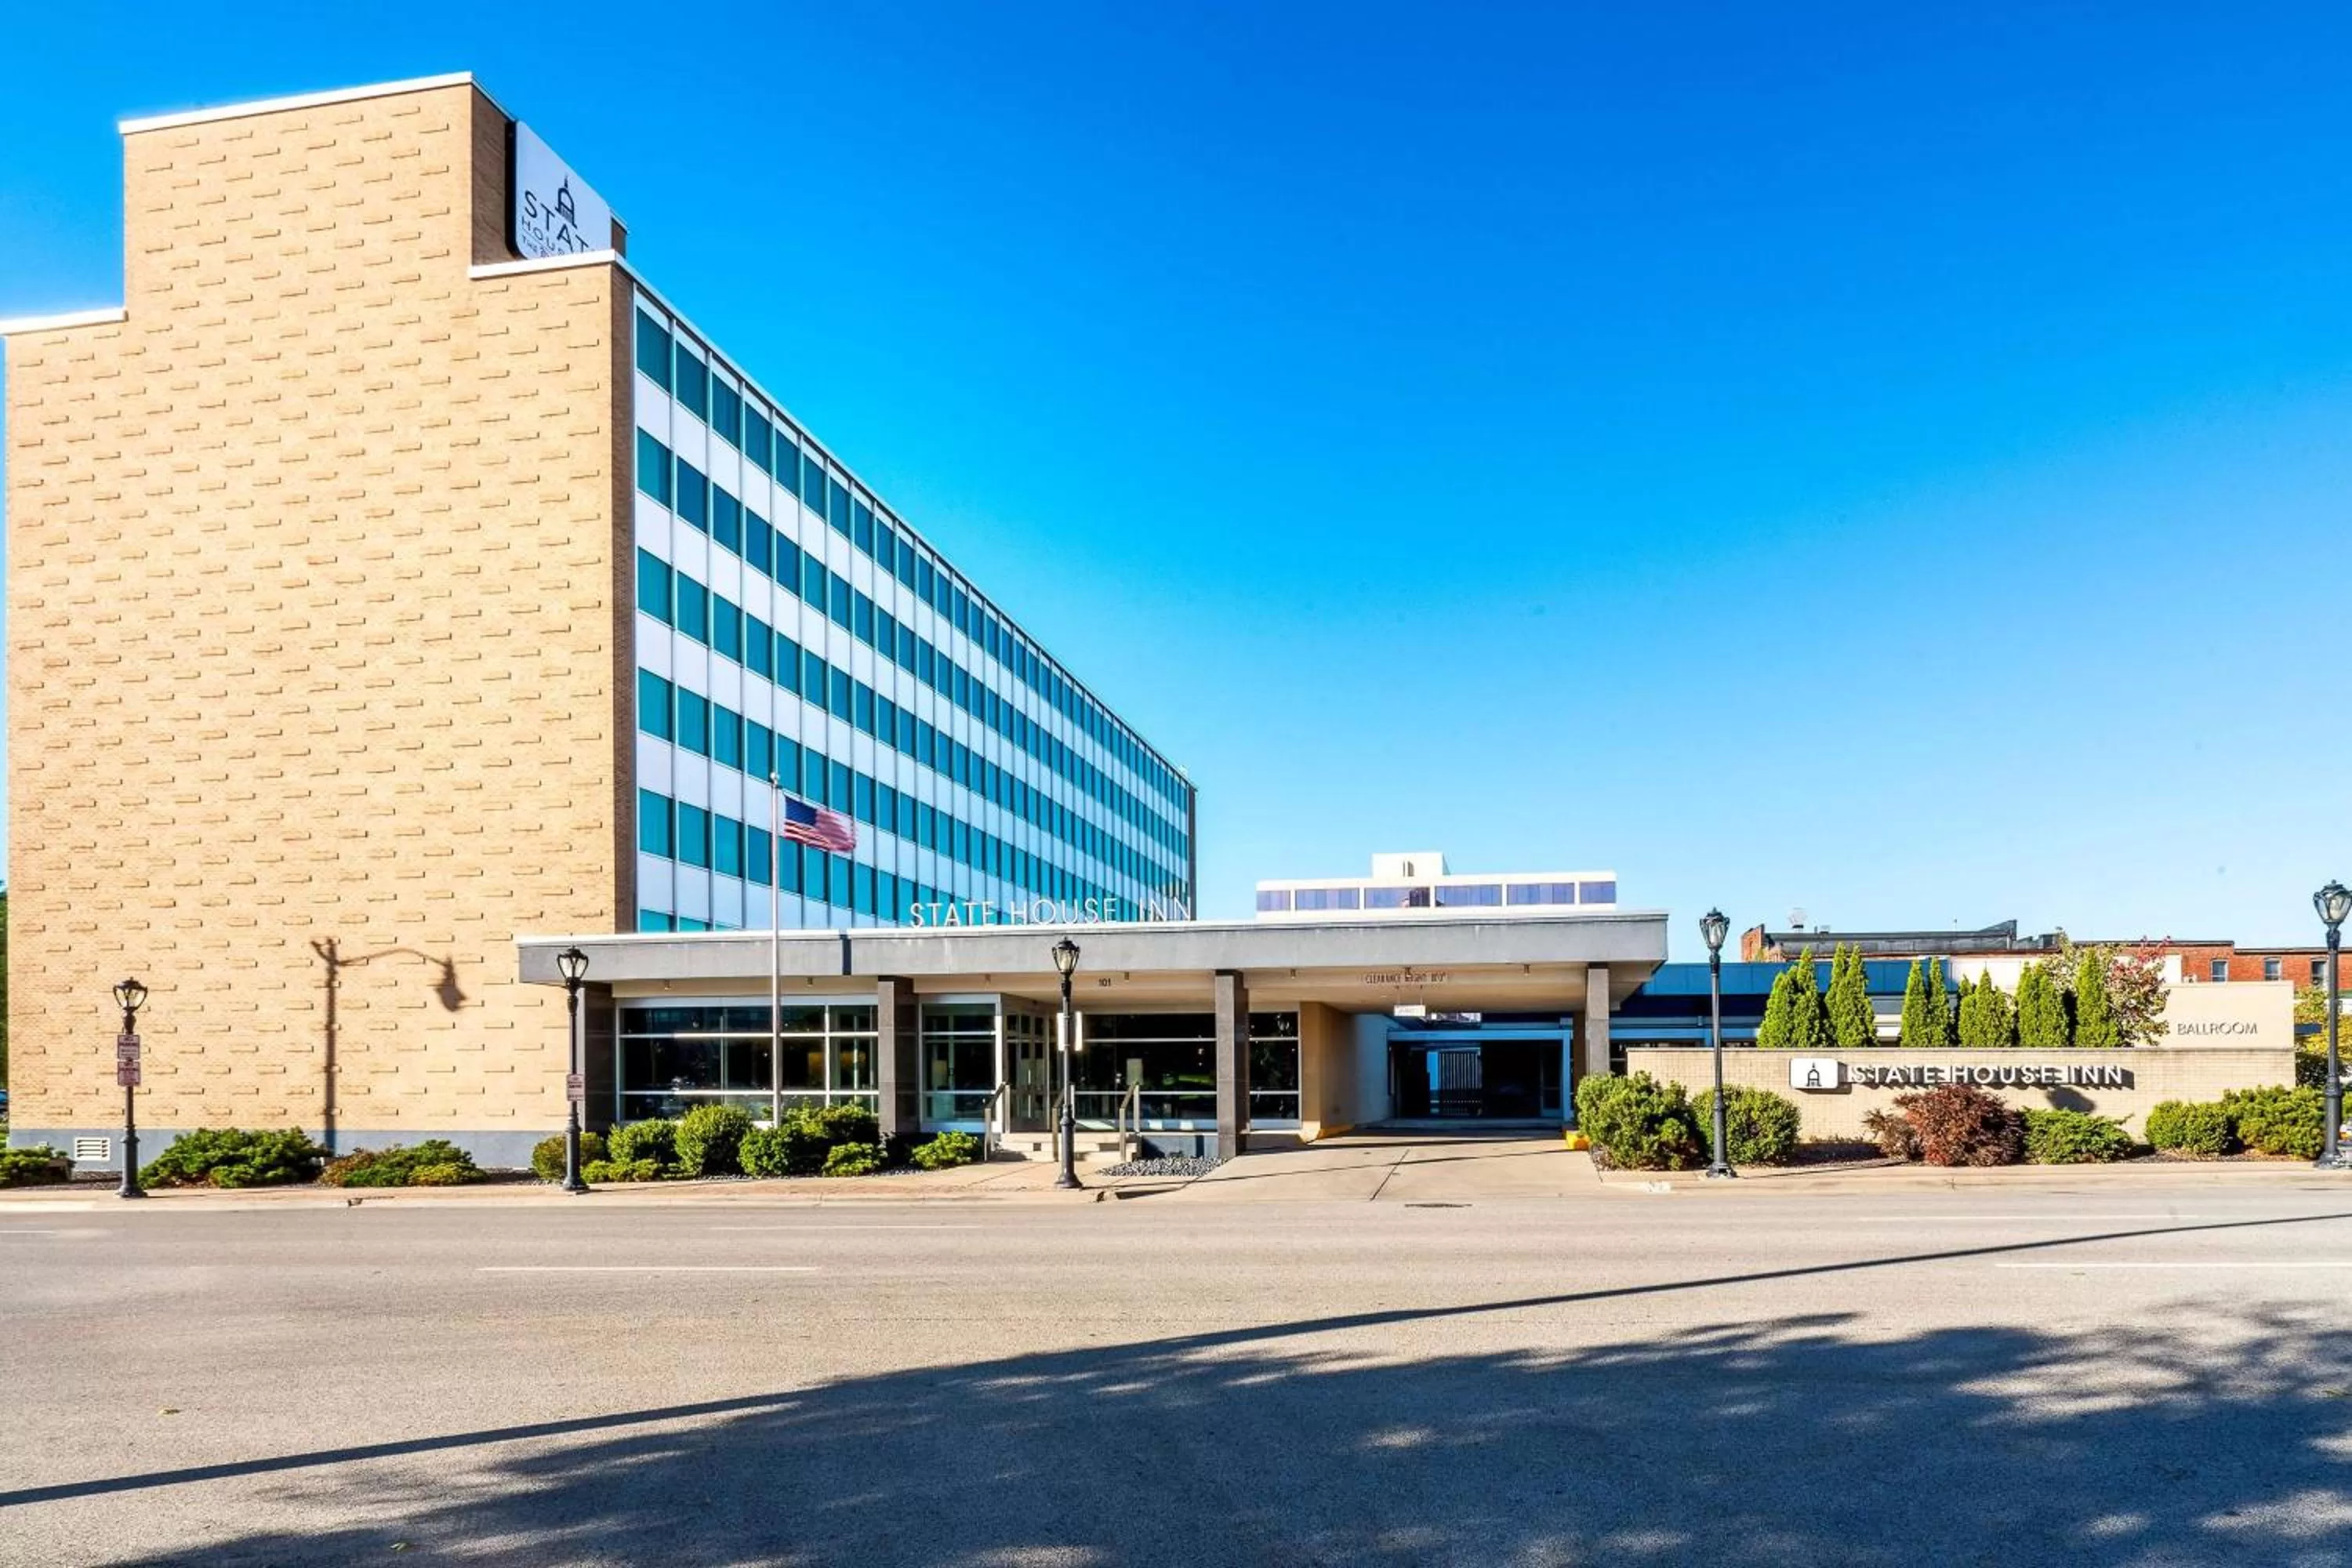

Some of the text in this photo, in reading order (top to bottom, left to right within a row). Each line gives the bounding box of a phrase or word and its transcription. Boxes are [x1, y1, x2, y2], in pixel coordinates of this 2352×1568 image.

[524, 191, 593, 253] STAT
[910, 897, 1191, 928] STATE HOUSE INN
[1098, 978, 1111, 987] 101
[2177, 1022, 2258, 1036] BALLROOM
[1852, 1063, 2123, 1084] STATE HOUSE INN
